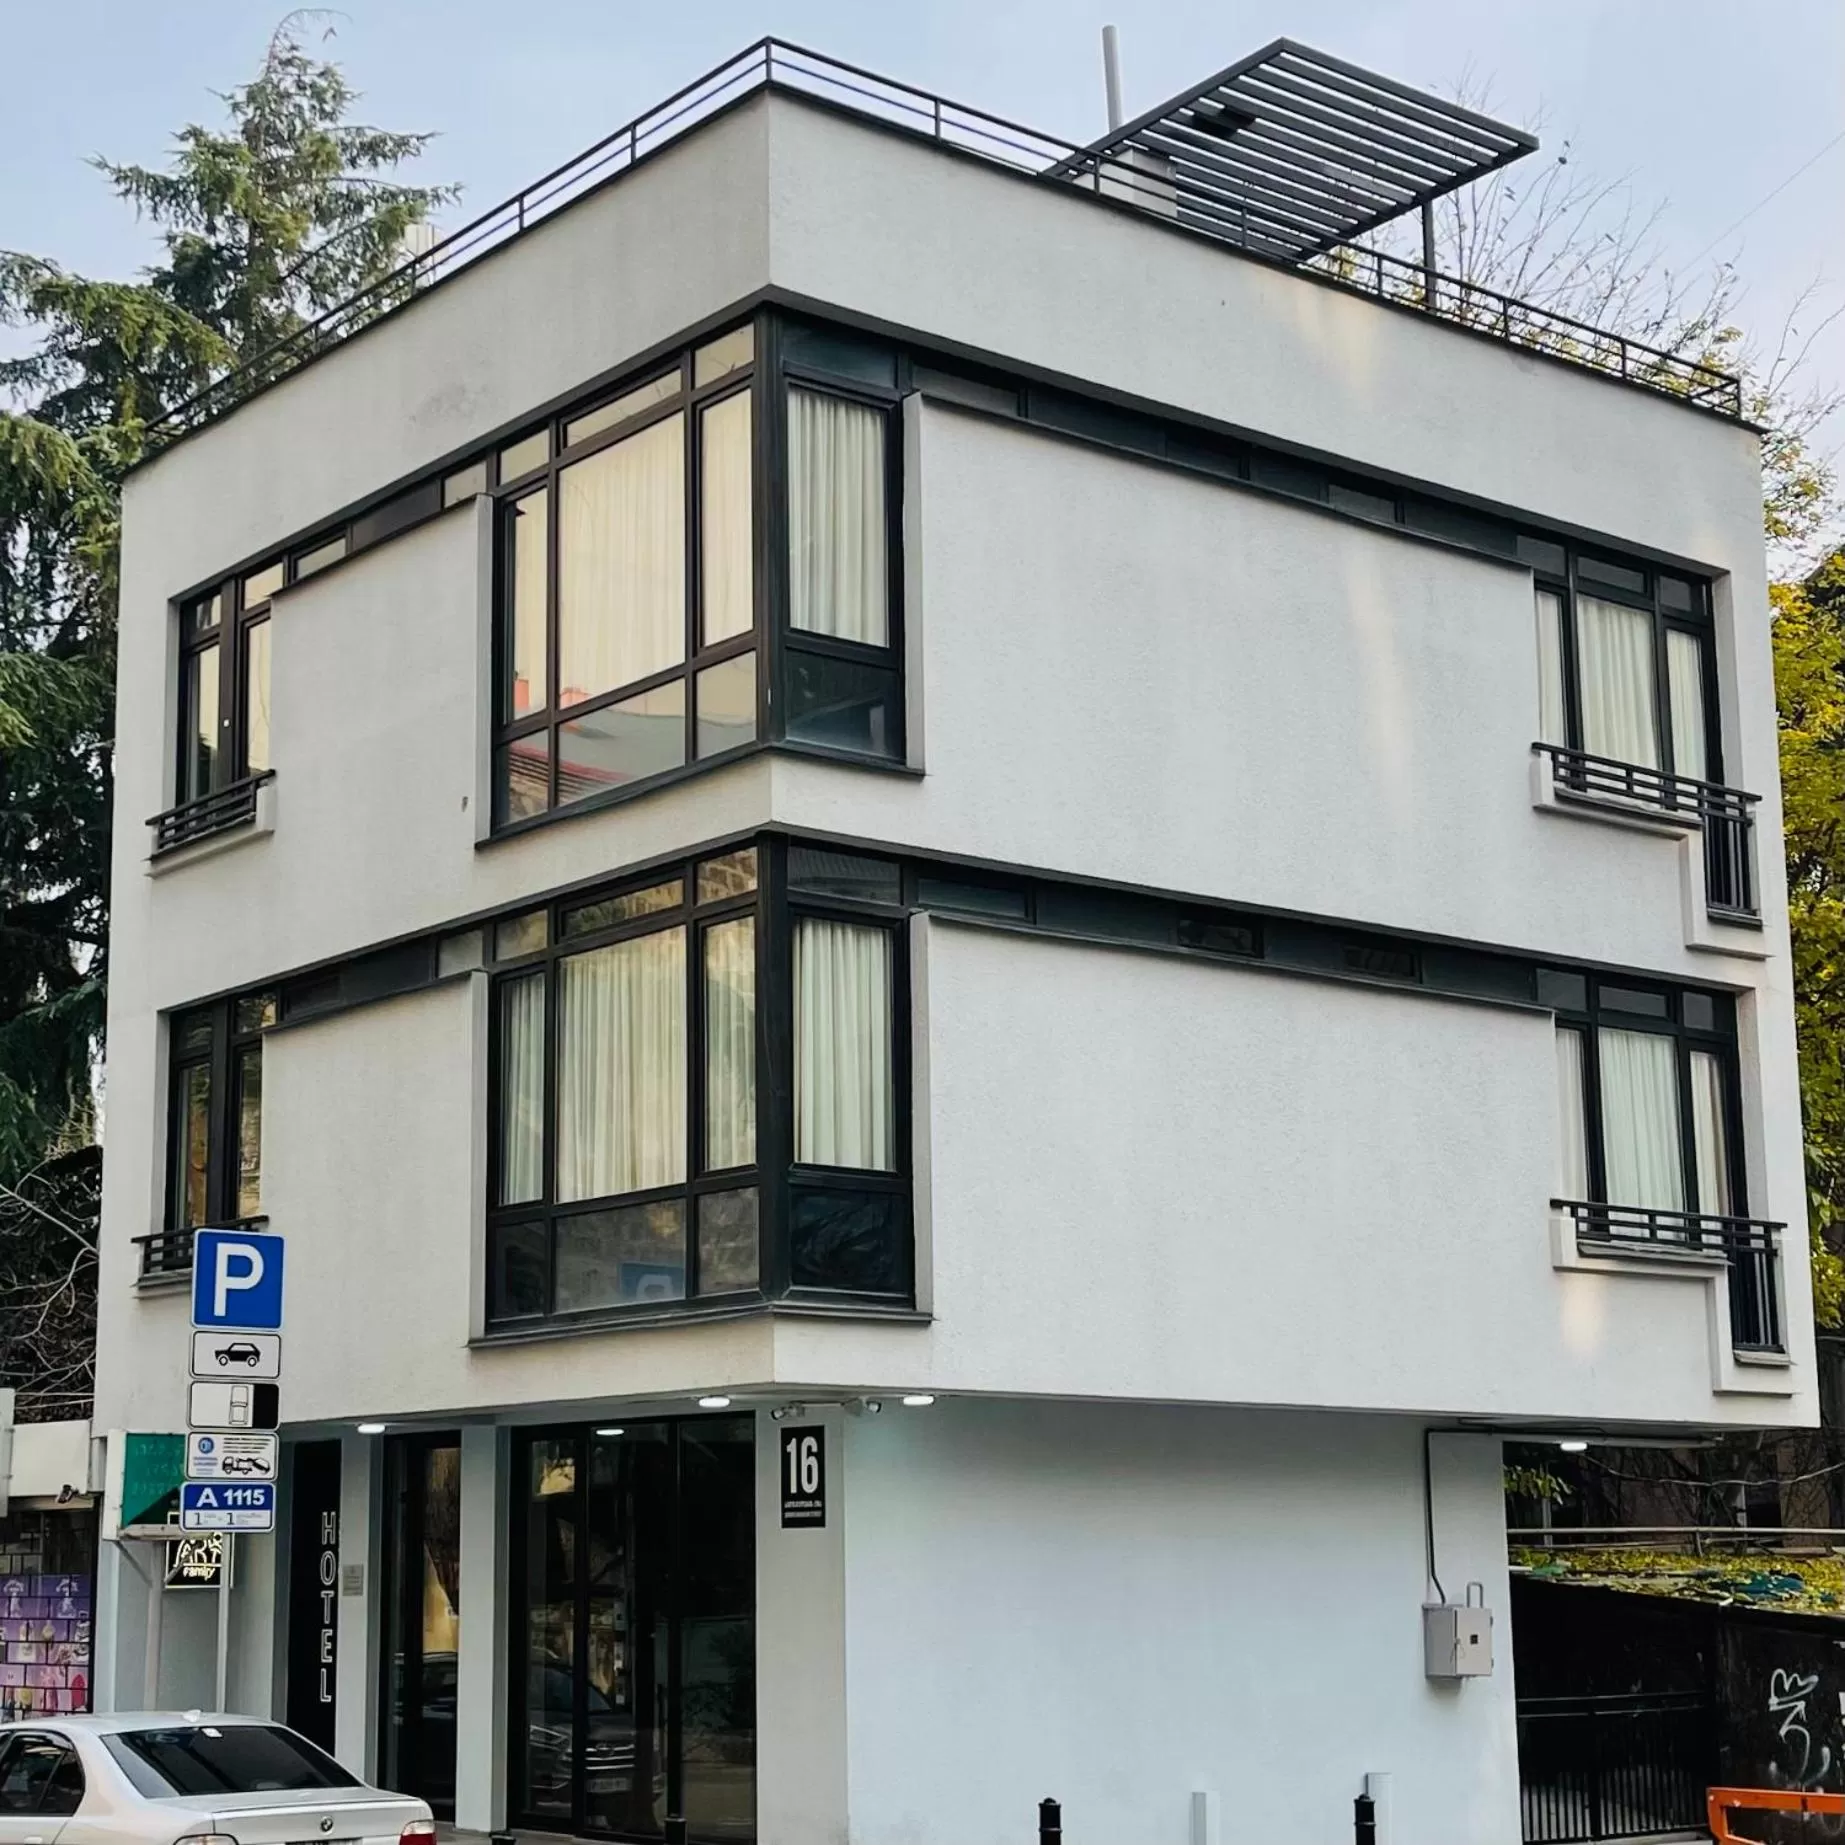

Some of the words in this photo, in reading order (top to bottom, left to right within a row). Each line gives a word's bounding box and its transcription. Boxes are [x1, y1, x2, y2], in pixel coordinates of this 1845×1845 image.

[213, 1242, 264, 1317] P
[196, 1487, 218, 1508] A
[223, 1488, 265, 1506] 1115
[786, 1436, 819, 1494] 16
[320, 1511, 336, 1702] HOTEL
